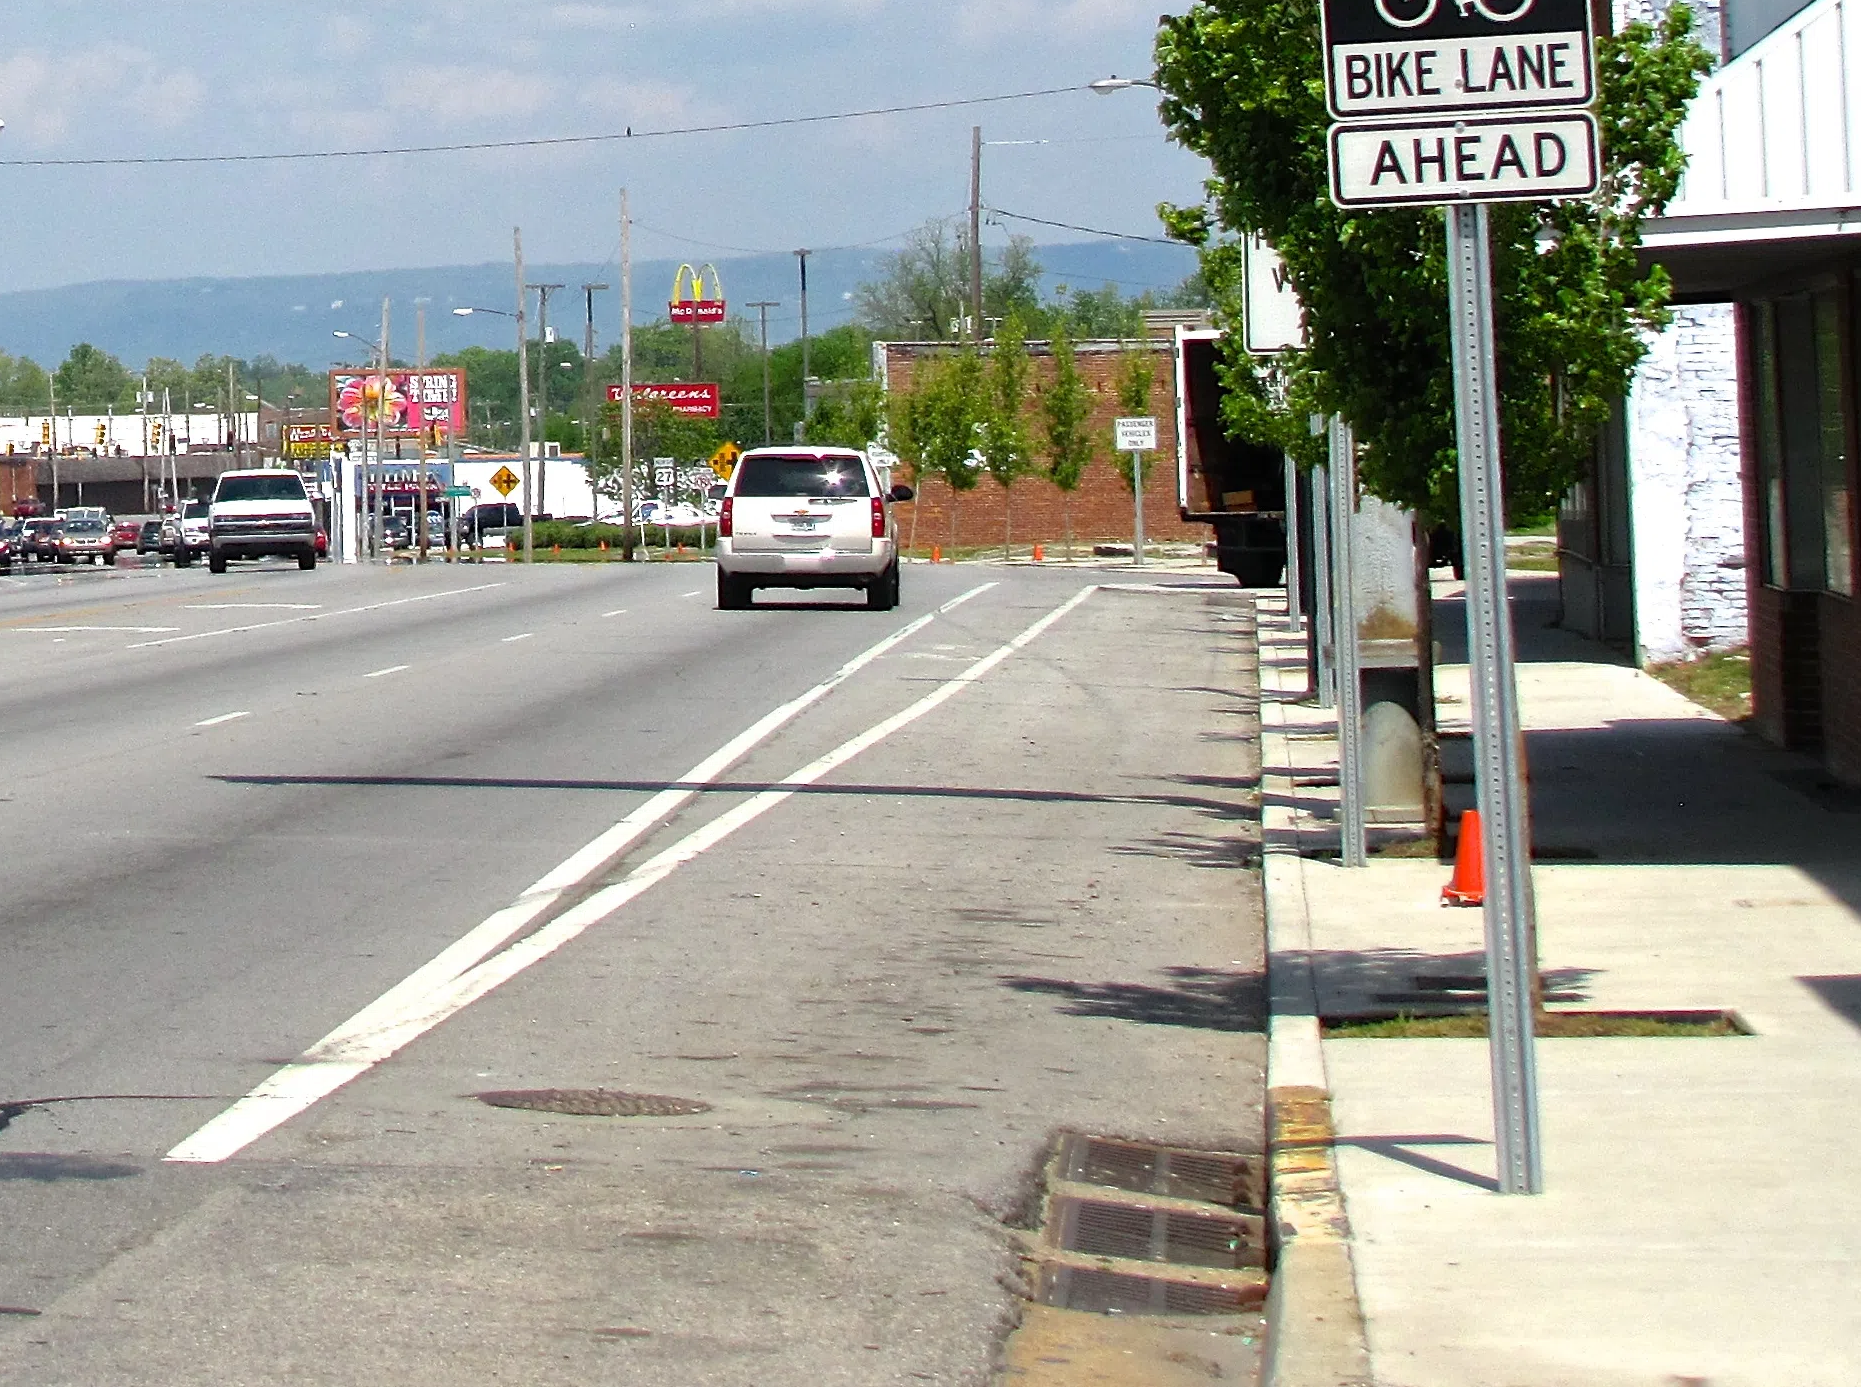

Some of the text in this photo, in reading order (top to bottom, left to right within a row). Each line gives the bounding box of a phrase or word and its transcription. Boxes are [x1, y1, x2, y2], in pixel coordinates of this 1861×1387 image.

[1344, 42, 1575, 101] BIKE LANE
[1369, 131, 1568, 187] AHEAD
[670, 306, 723, 315] McDnald's
[657, 471, 672, 482] 27
